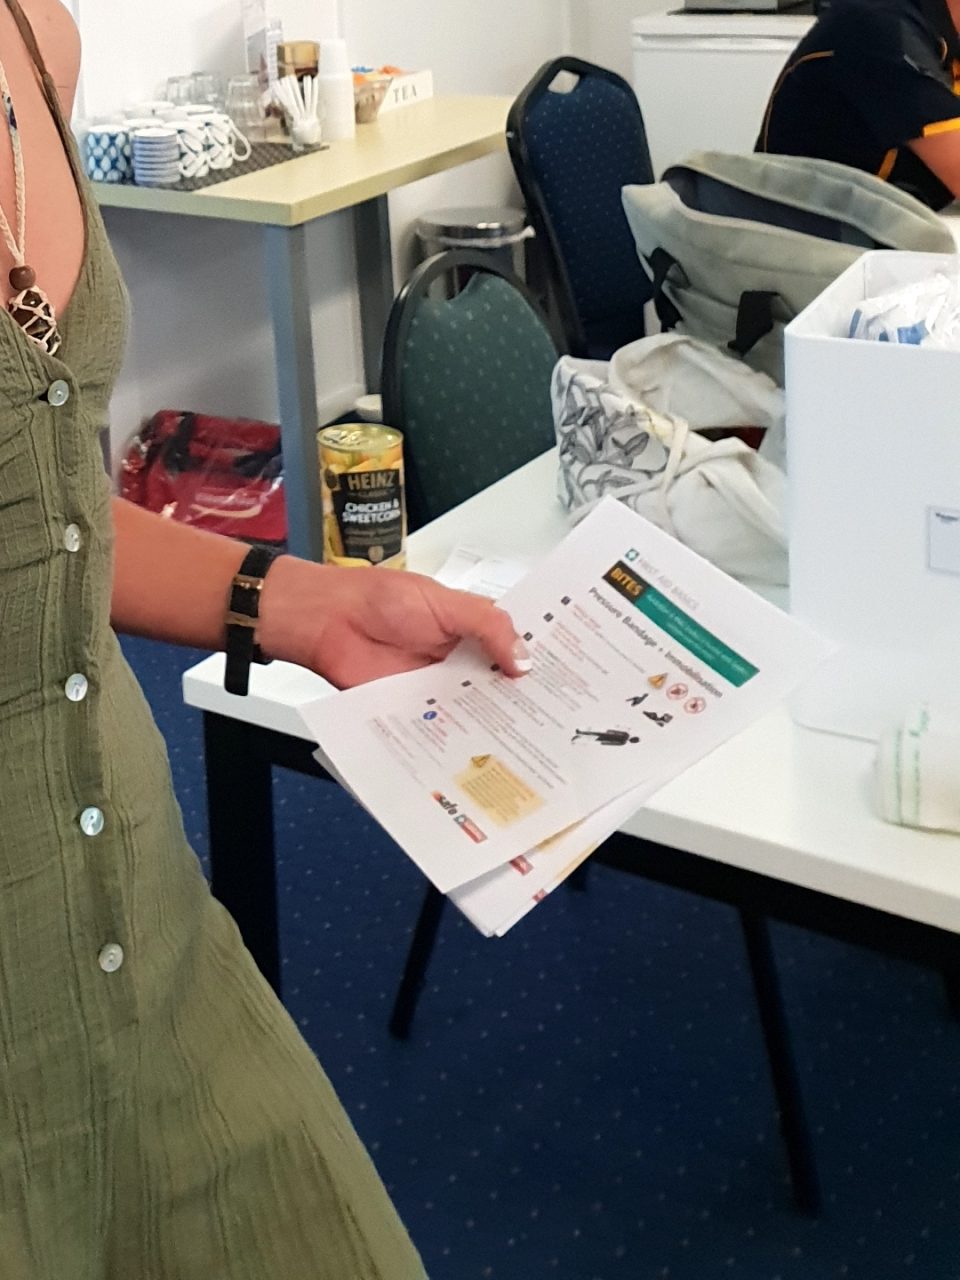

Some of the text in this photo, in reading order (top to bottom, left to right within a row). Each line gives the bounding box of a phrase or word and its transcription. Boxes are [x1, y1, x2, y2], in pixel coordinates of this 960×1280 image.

[393, 83, 420, 104] TEA
[347, 472, 395, 490] HEINZ
[345, 501, 392, 512] CHICKEN
[610, 567, 644, 596] BITES
[589, 586, 623, 618] Pressure
[622, 615, 658, 648] Bandage
